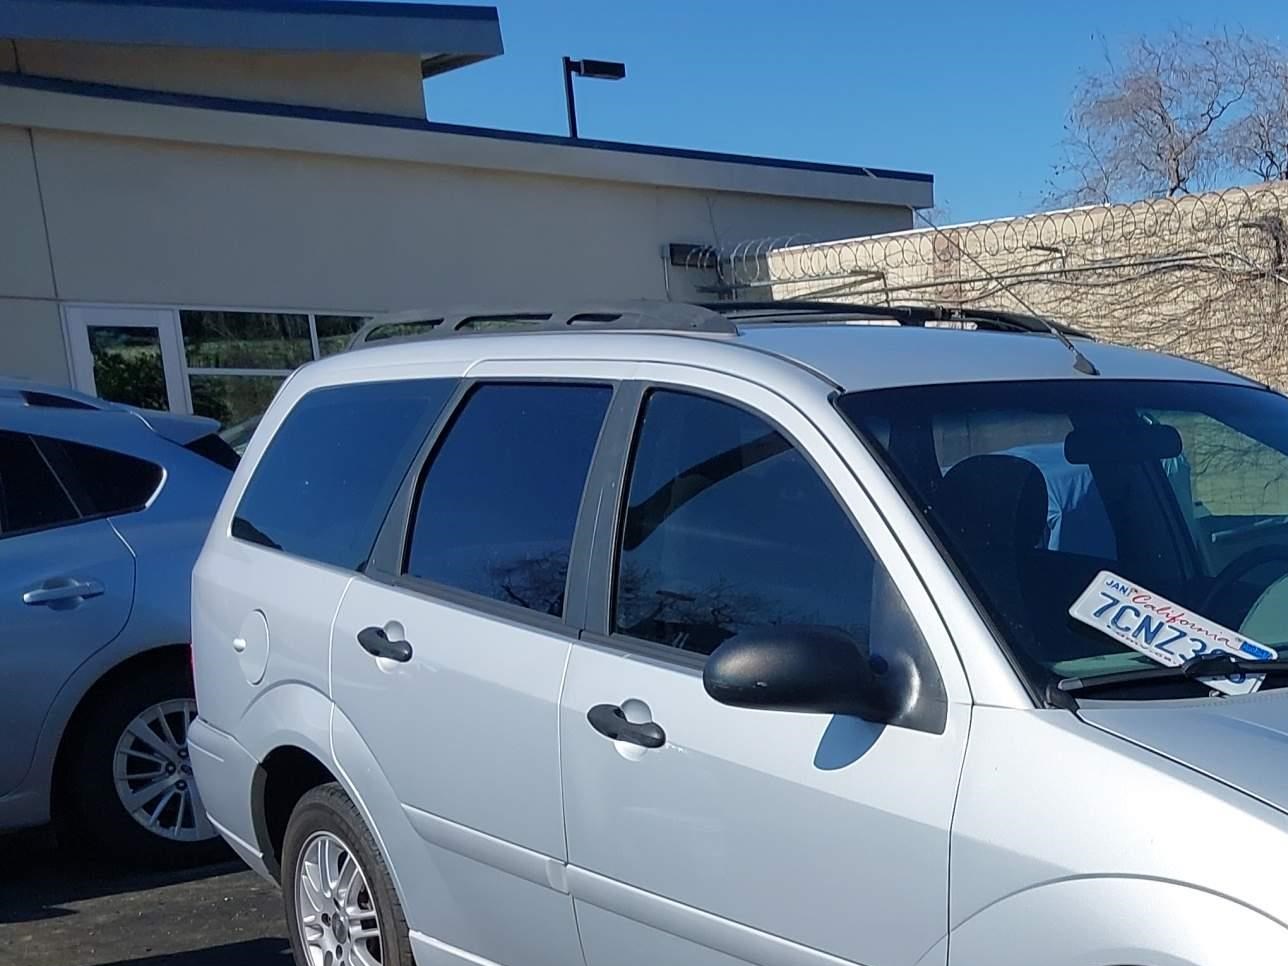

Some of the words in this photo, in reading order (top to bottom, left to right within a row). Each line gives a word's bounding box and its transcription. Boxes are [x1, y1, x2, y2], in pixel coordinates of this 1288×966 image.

[1105, 579, 1130, 596] JAN
[1093, 592, 1246, 684] 7CNZ3
[1132, 594, 1240, 651] California
